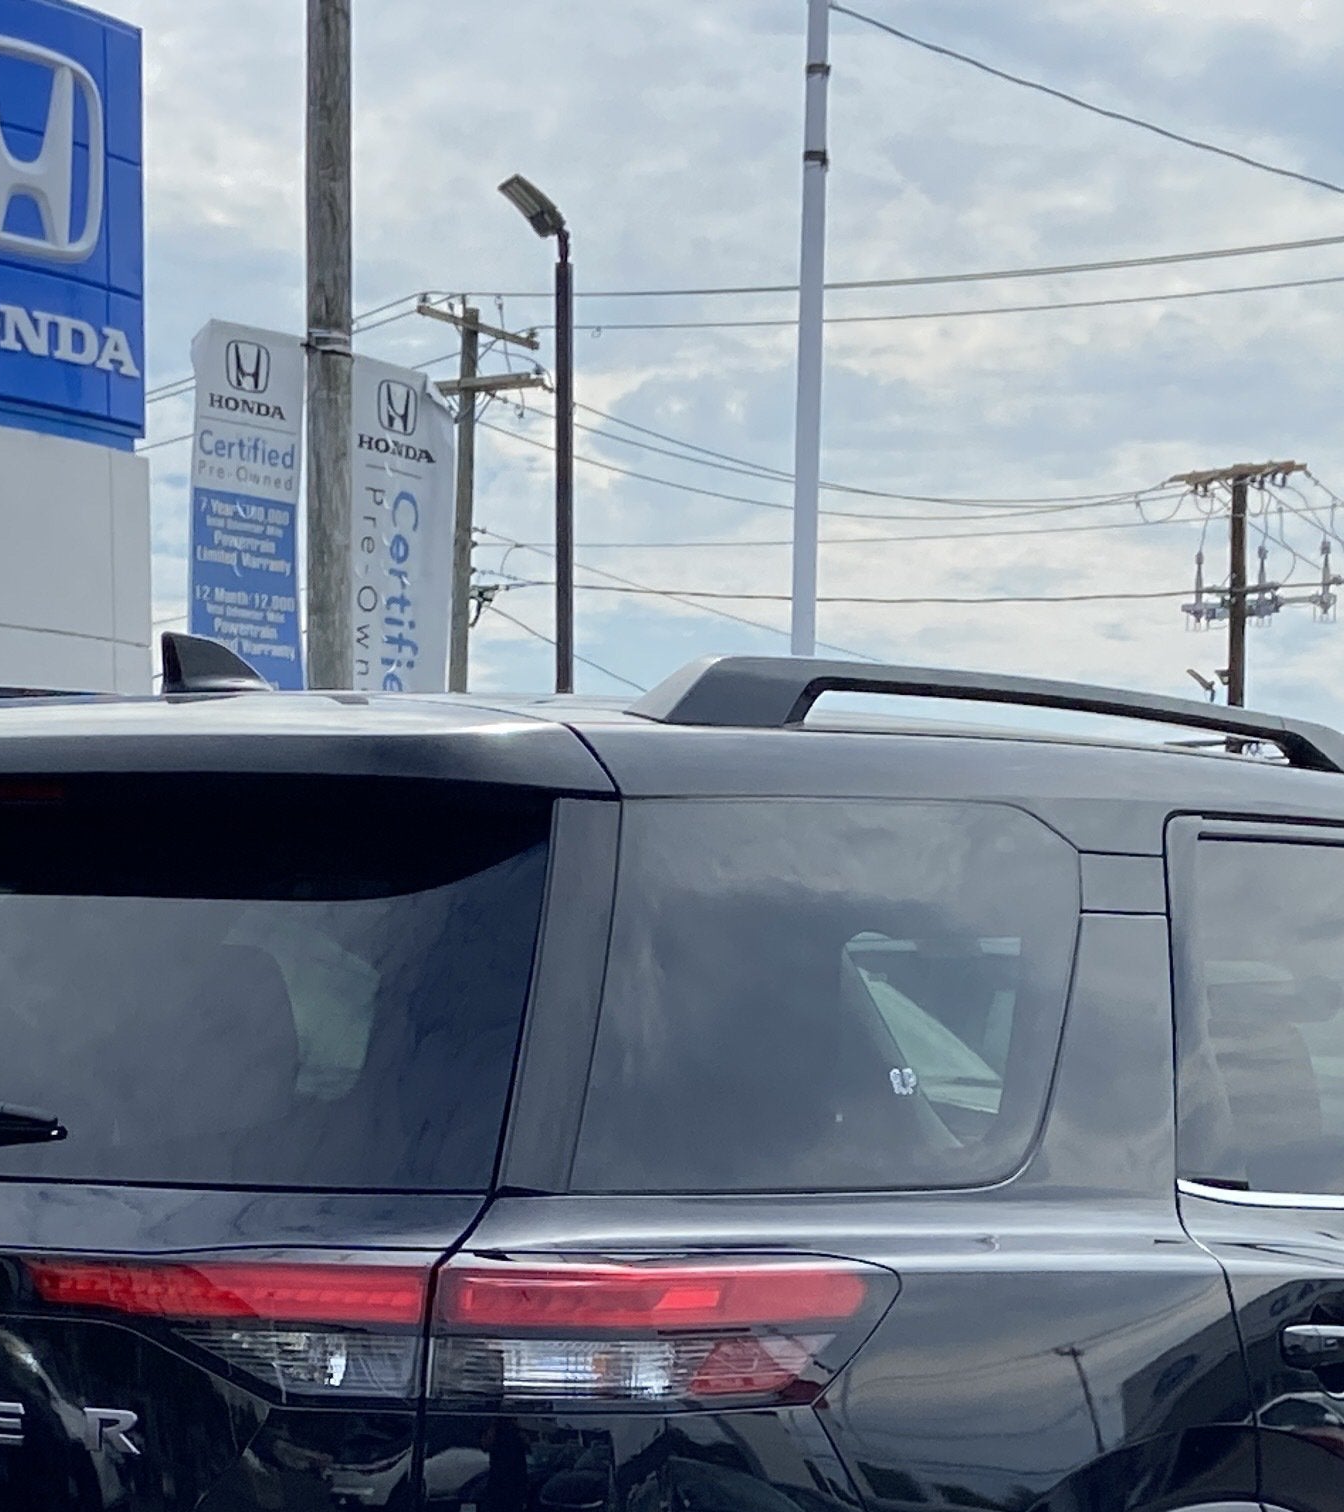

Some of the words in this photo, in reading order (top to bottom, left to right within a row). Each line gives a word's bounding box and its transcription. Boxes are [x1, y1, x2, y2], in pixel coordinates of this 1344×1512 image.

[208, 392, 286, 421] HONDA
[199, 429, 295, 469] Certified
[358, 433, 436, 464] HONDA
[198, 460, 293, 491] Pre-Owned
[356, 487, 385, 691] Pre-Own
